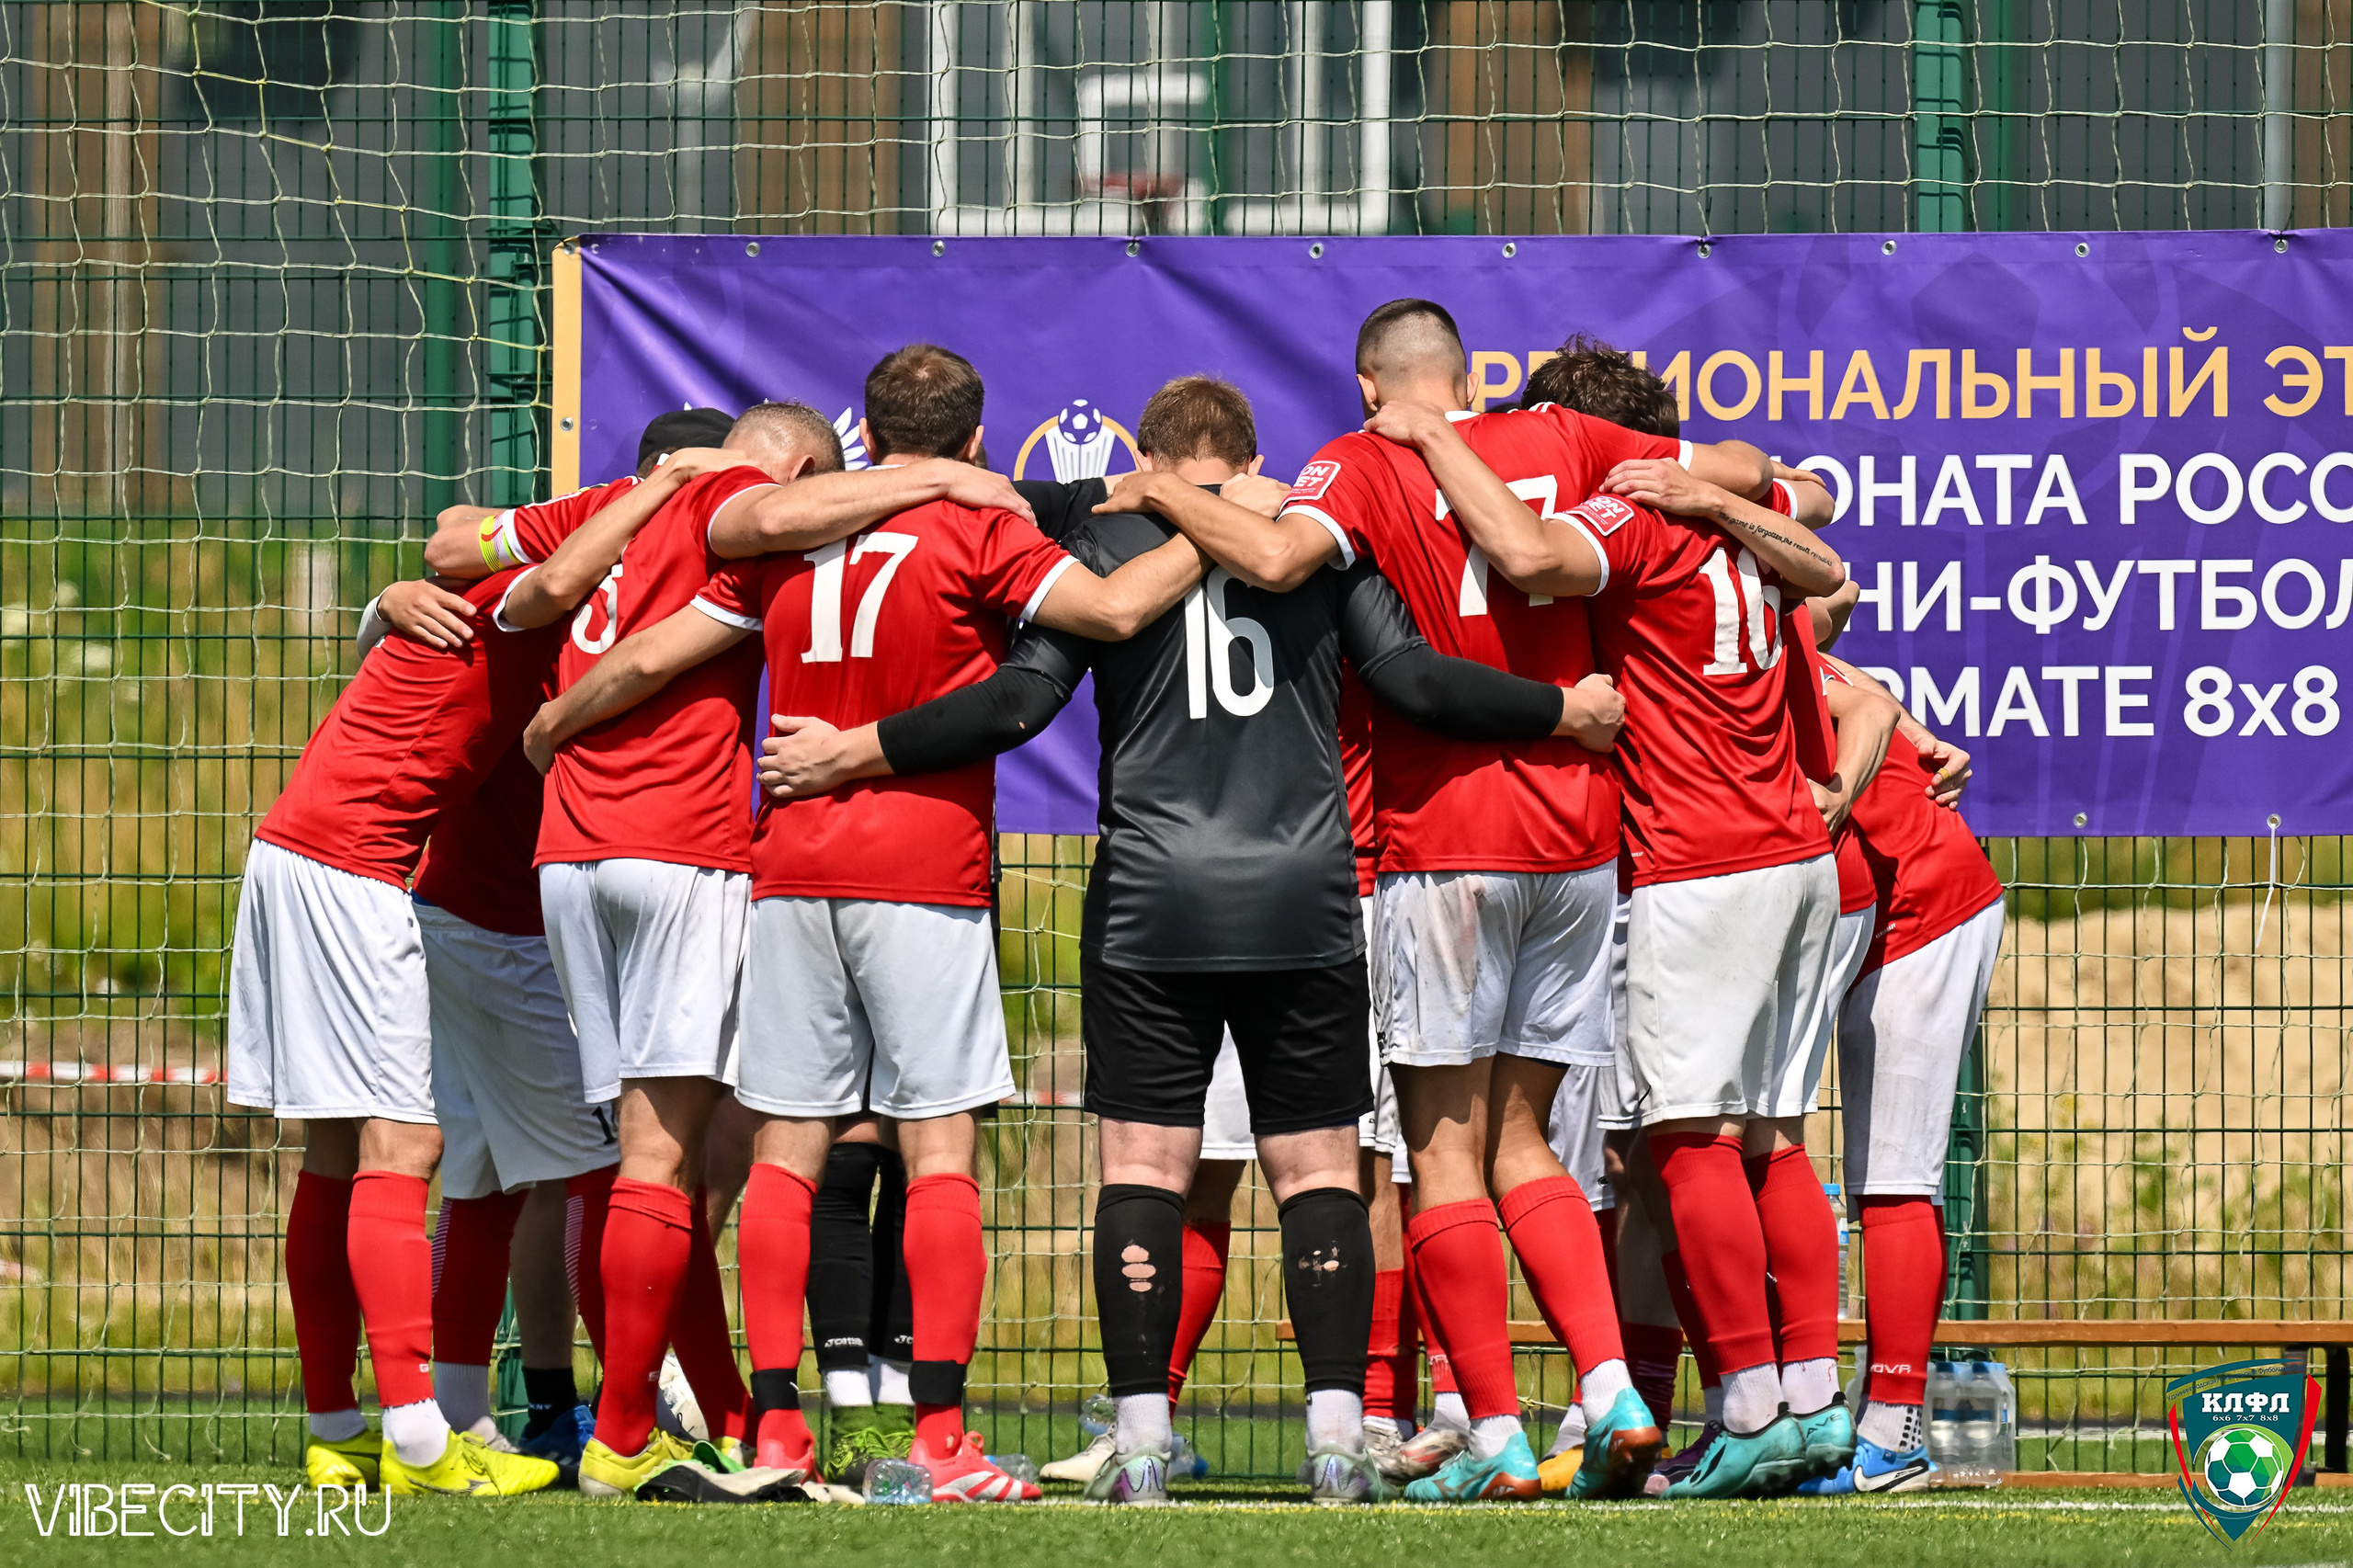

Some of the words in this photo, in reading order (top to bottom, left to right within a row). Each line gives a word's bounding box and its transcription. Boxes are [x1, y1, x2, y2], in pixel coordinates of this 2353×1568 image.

[1471, 326, 2229, 422] РИОНАЛЬНЫЙ
[1728, 517, 1749, 528] game
[1770, 454, 2088, 527] ОНАТА
[801, 531, 919, 664] 17
[1183, 566, 1275, 720] 16
